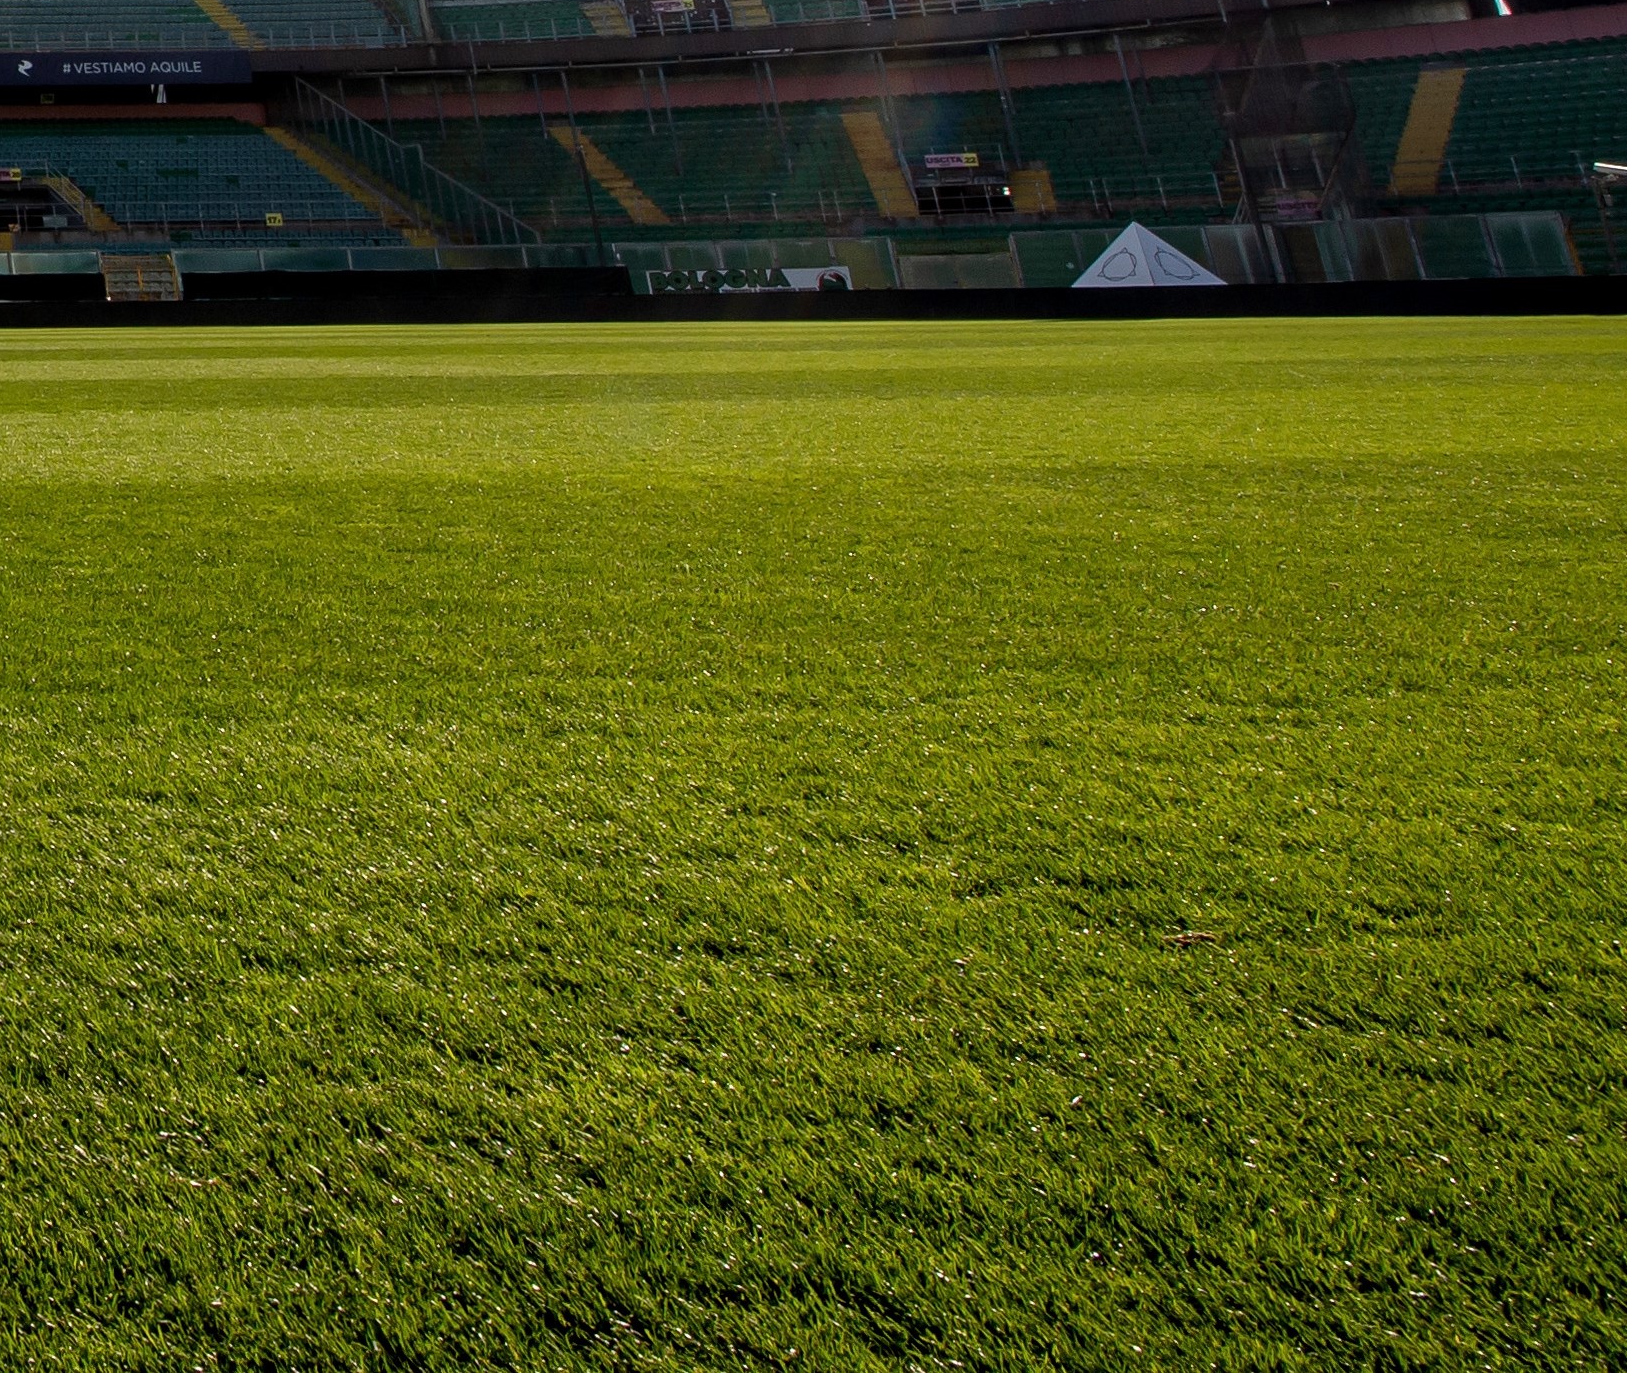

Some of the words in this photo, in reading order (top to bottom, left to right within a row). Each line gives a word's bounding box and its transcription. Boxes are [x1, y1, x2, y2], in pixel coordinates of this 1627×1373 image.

[151, 61, 203, 74] AQUILE
[926, 155, 963, 164] USCITA
[964, 155, 977, 164] 22
[649, 267, 792, 292] BOLOGNA
